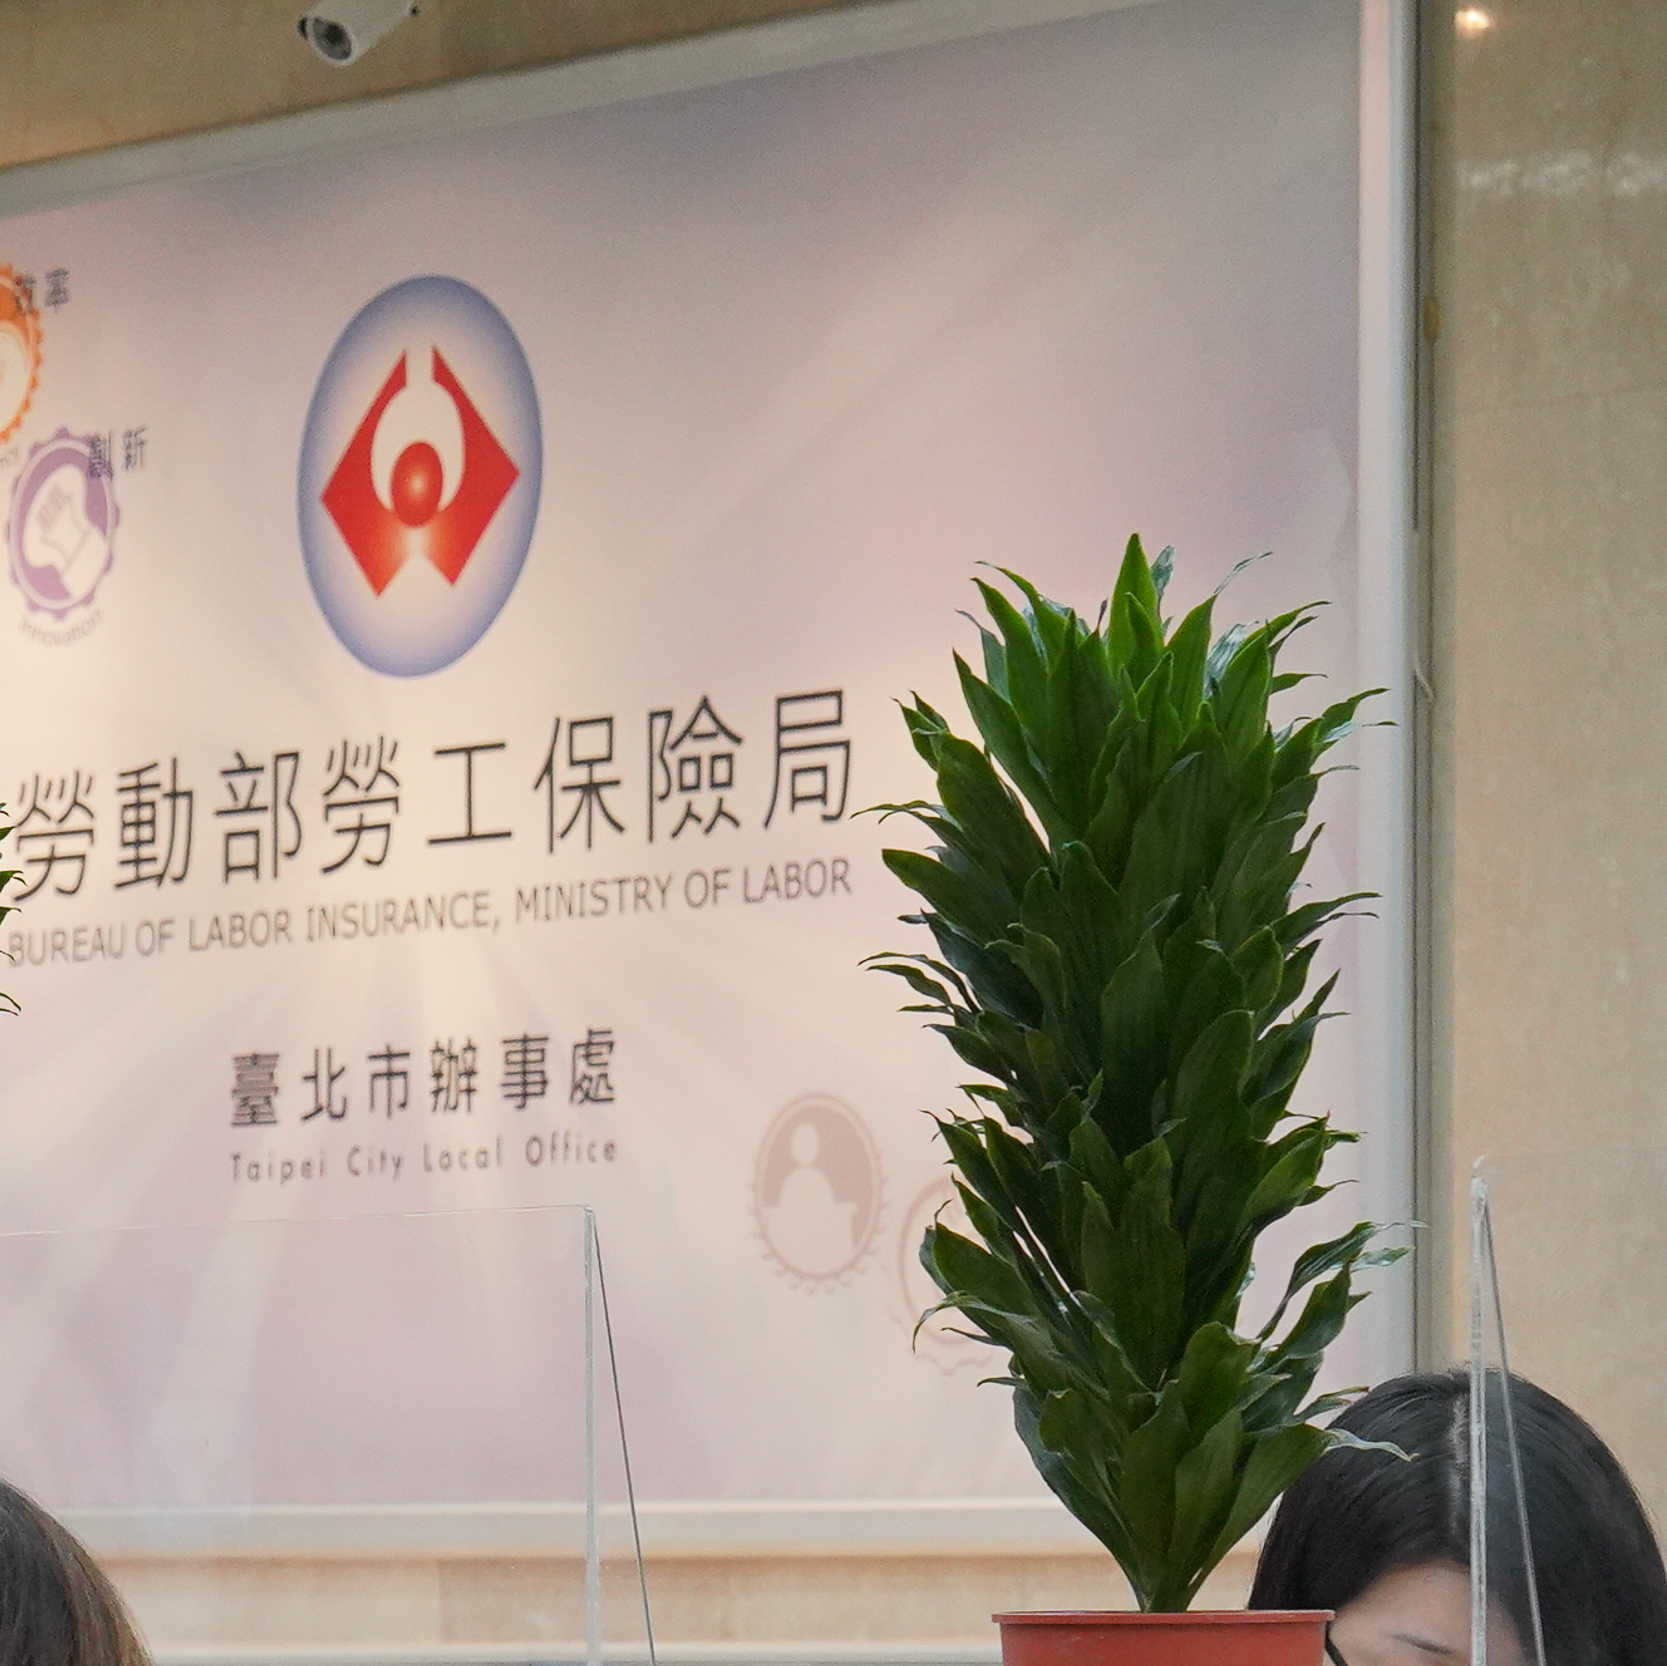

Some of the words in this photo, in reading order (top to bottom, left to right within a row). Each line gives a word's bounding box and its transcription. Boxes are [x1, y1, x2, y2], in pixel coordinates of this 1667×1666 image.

[18, 609, 104, 649] Innovation
[13, 690, 853, 903] 勞動部勞工保險局
[9, 921, 125, 967] BUREAU
[134, 917, 175, 957] OF
[188, 904, 294, 953] LABOR
[304, 889, 502, 943] INSURANCE,
[514, 873, 675, 923] MINISTRY
[683, 868, 731, 909] OF
[742, 857, 853, 903] LABOR
[230, 1027, 616, 1128] 臺北市辦事處
[230, 1151, 326, 1185] Taipei
[346, 1146, 406, 1180] City
[422, 1135, 503, 1174] Local
[525, 1129, 618, 1169] Office
